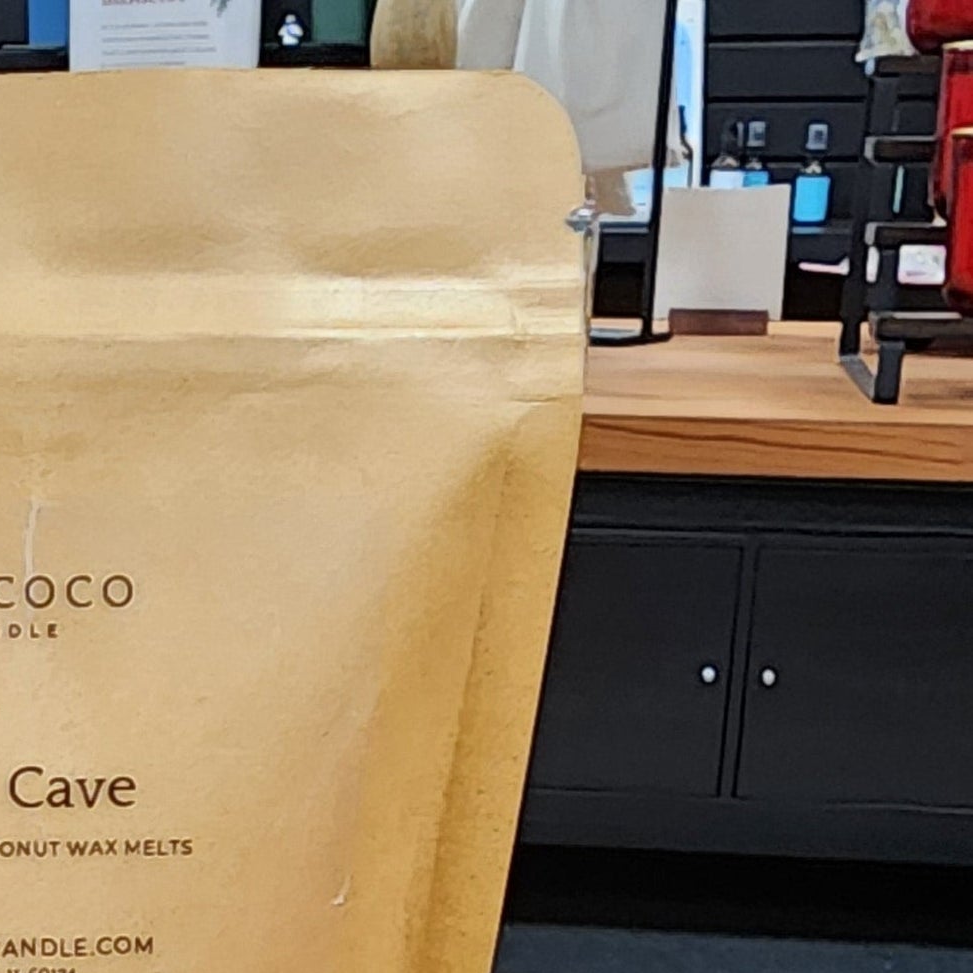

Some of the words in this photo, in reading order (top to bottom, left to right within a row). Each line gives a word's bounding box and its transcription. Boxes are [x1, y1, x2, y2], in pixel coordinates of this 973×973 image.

[8, 766, 137, 808] Cave
[66, 840, 118, 857] WAX
[124, 839, 193, 857] MELTS
